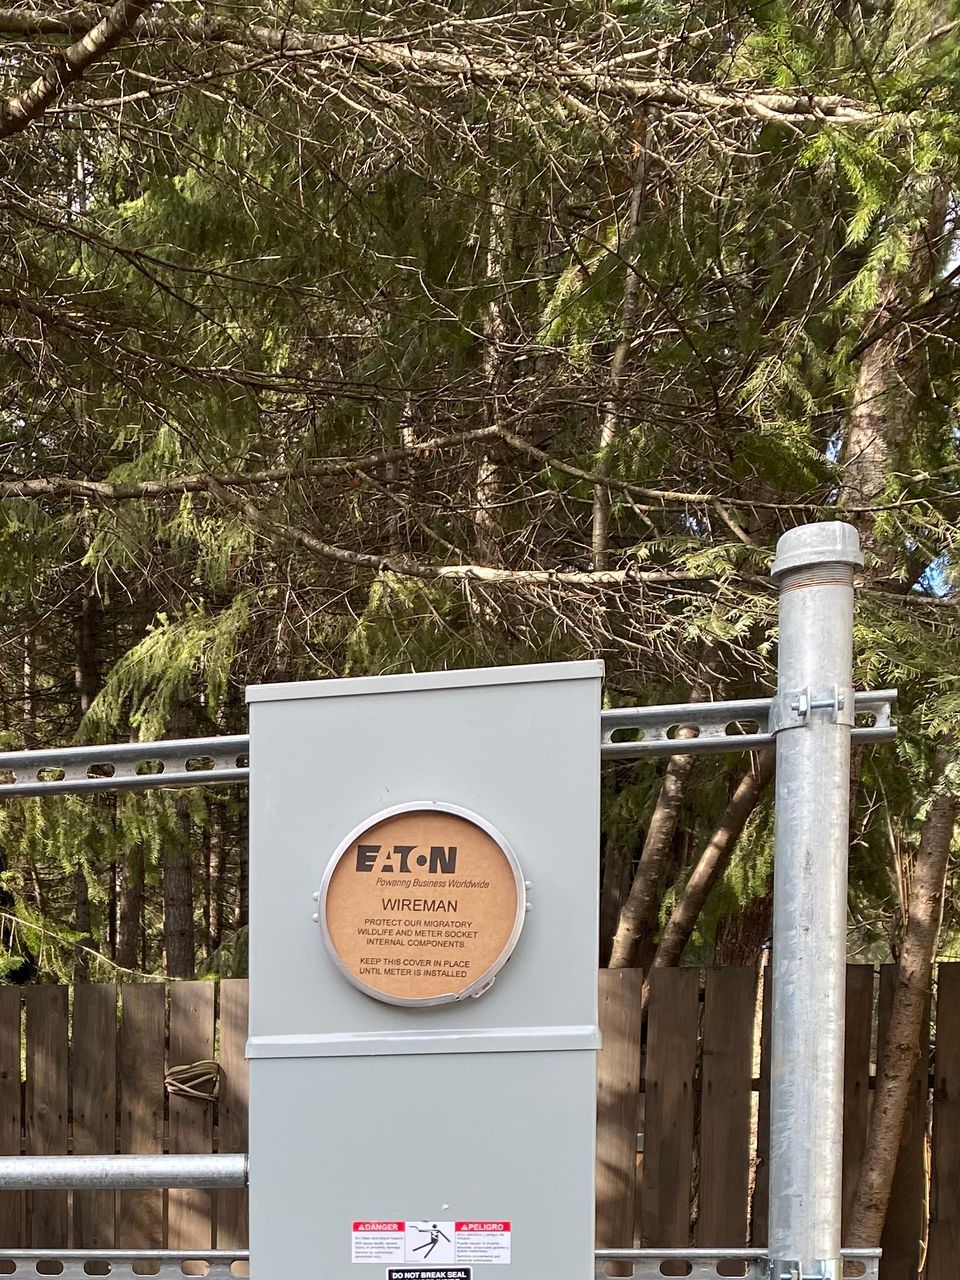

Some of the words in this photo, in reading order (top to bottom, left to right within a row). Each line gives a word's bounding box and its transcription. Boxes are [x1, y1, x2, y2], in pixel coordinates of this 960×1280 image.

[355, 844, 457, 874] EATON
[376, 877, 411, 889] Powering
[412, 878, 447, 888] Business
[448, 879, 490, 889] Worldwide
[381, 898, 458, 912] WIREMAN
[364, 918, 402, 927] PROTECT
[403, 919, 422, 927] OUR
[423, 920, 473, 928] MIGRATORY
[357, 928, 394, 936] WILDLIFE
[395, 929, 413, 937] AND
[414, 930, 443, 938] METER
[444, 930, 479, 939] SOCKET
[366, 938, 405, 946] INTERNAL
[360, 957, 382, 965] KEEP
[383, 958, 402, 966] THIS
[402, 958, 432, 967] COVER
[443, 960, 471, 968] PLACE
[359, 967, 383, 975] UNTIL
[383, 968, 412, 976] METER
[413, 969, 421, 977] IS
[423, 969, 468, 978] INSTALLED
[364, 1223, 399, 1231] DANGER
[468, 1223, 504, 1231] PELIGRO
